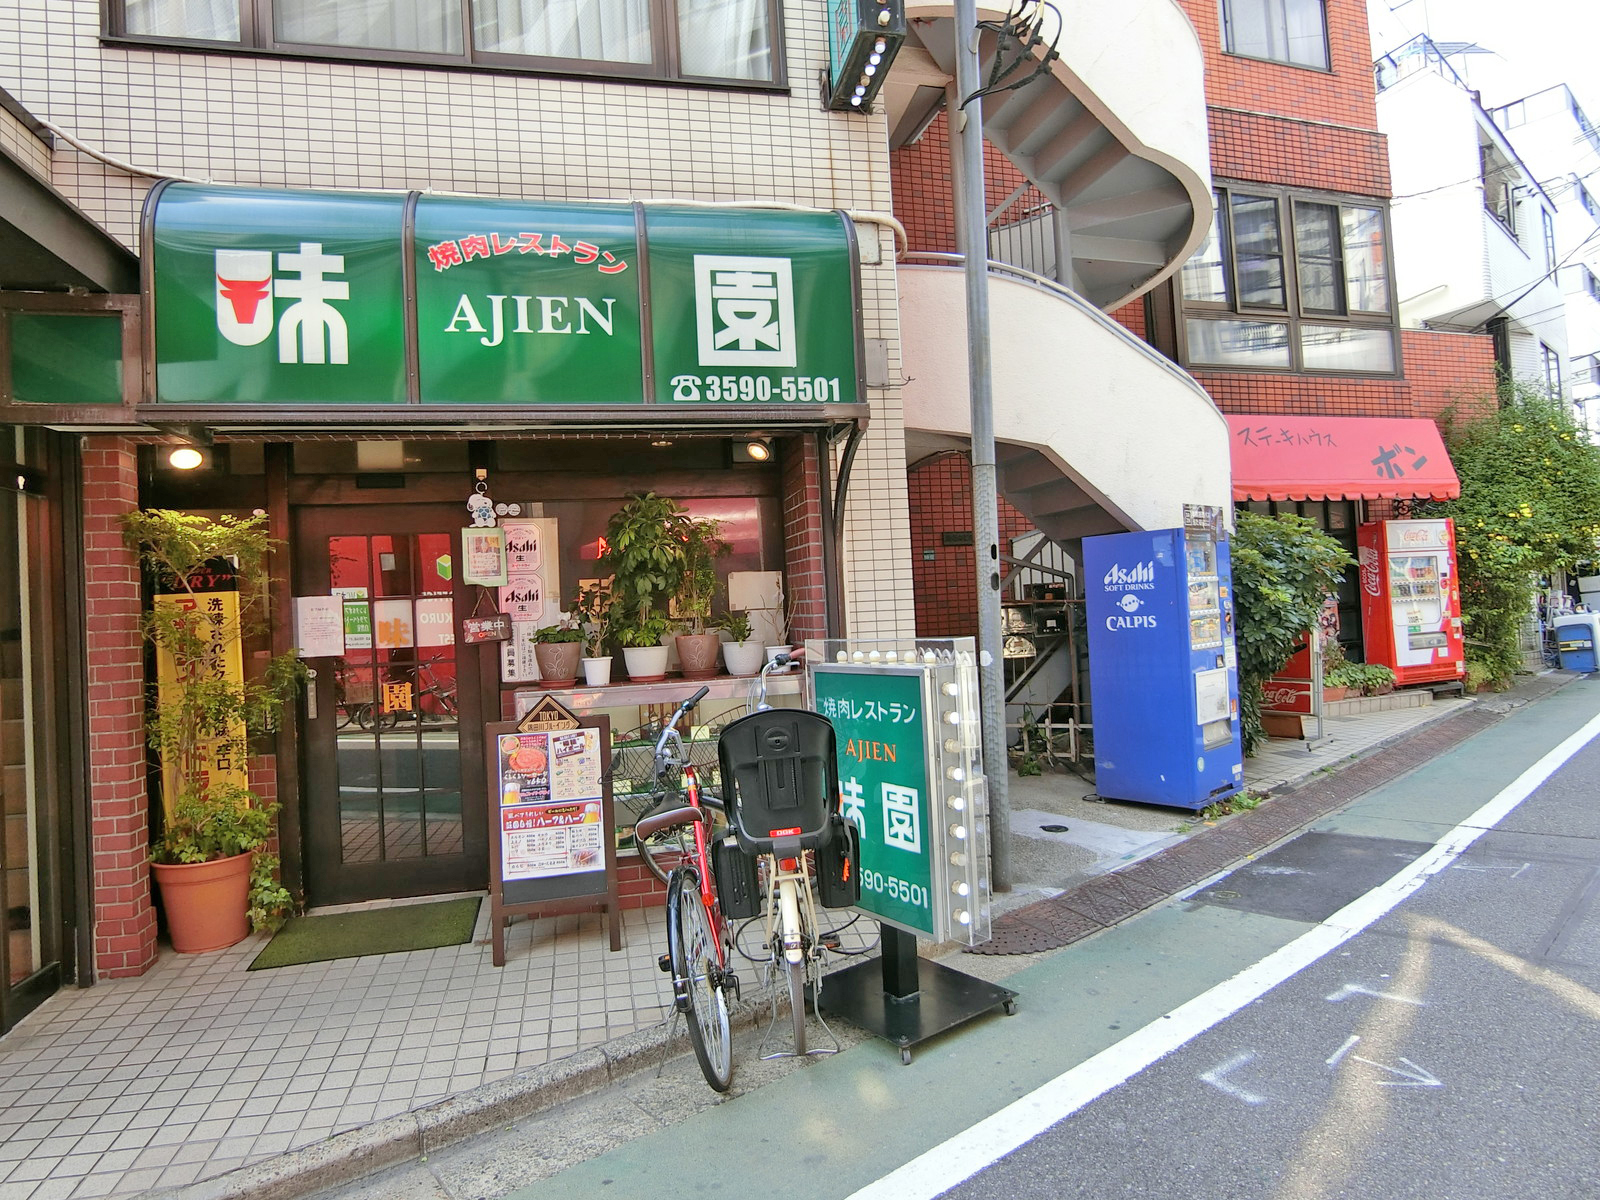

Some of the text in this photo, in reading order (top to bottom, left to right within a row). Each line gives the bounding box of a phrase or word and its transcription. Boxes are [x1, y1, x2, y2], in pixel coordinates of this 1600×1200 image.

[427, 232, 629, 274] 焼肉レストラン
[444, 293, 617, 347] AJIEN
[693, 254, 798, 369] 園
[705, 375, 841, 402] 3590-5501
[1237, 426, 1338, 448] ステーキハウス
[1370, 443, 1428, 480] ボン
[504, 539, 537, 553] Asahi
[516, 554, 526, 562] 生
[1103, 560, 1154, 585] Asahi
[505, 588, 539, 603] Asahi
[1104, 582, 1155, 593] SOFT DRINKS
[518, 604, 527, 612] 生
[467, 619, 505, 633] 営業中
[1105, 615, 1157, 632] CALPIS
[539, 710, 559, 721] TOKYO
[823, 697, 916, 724] 焼肉レストラン
[845, 738, 897, 763] AJIEN
